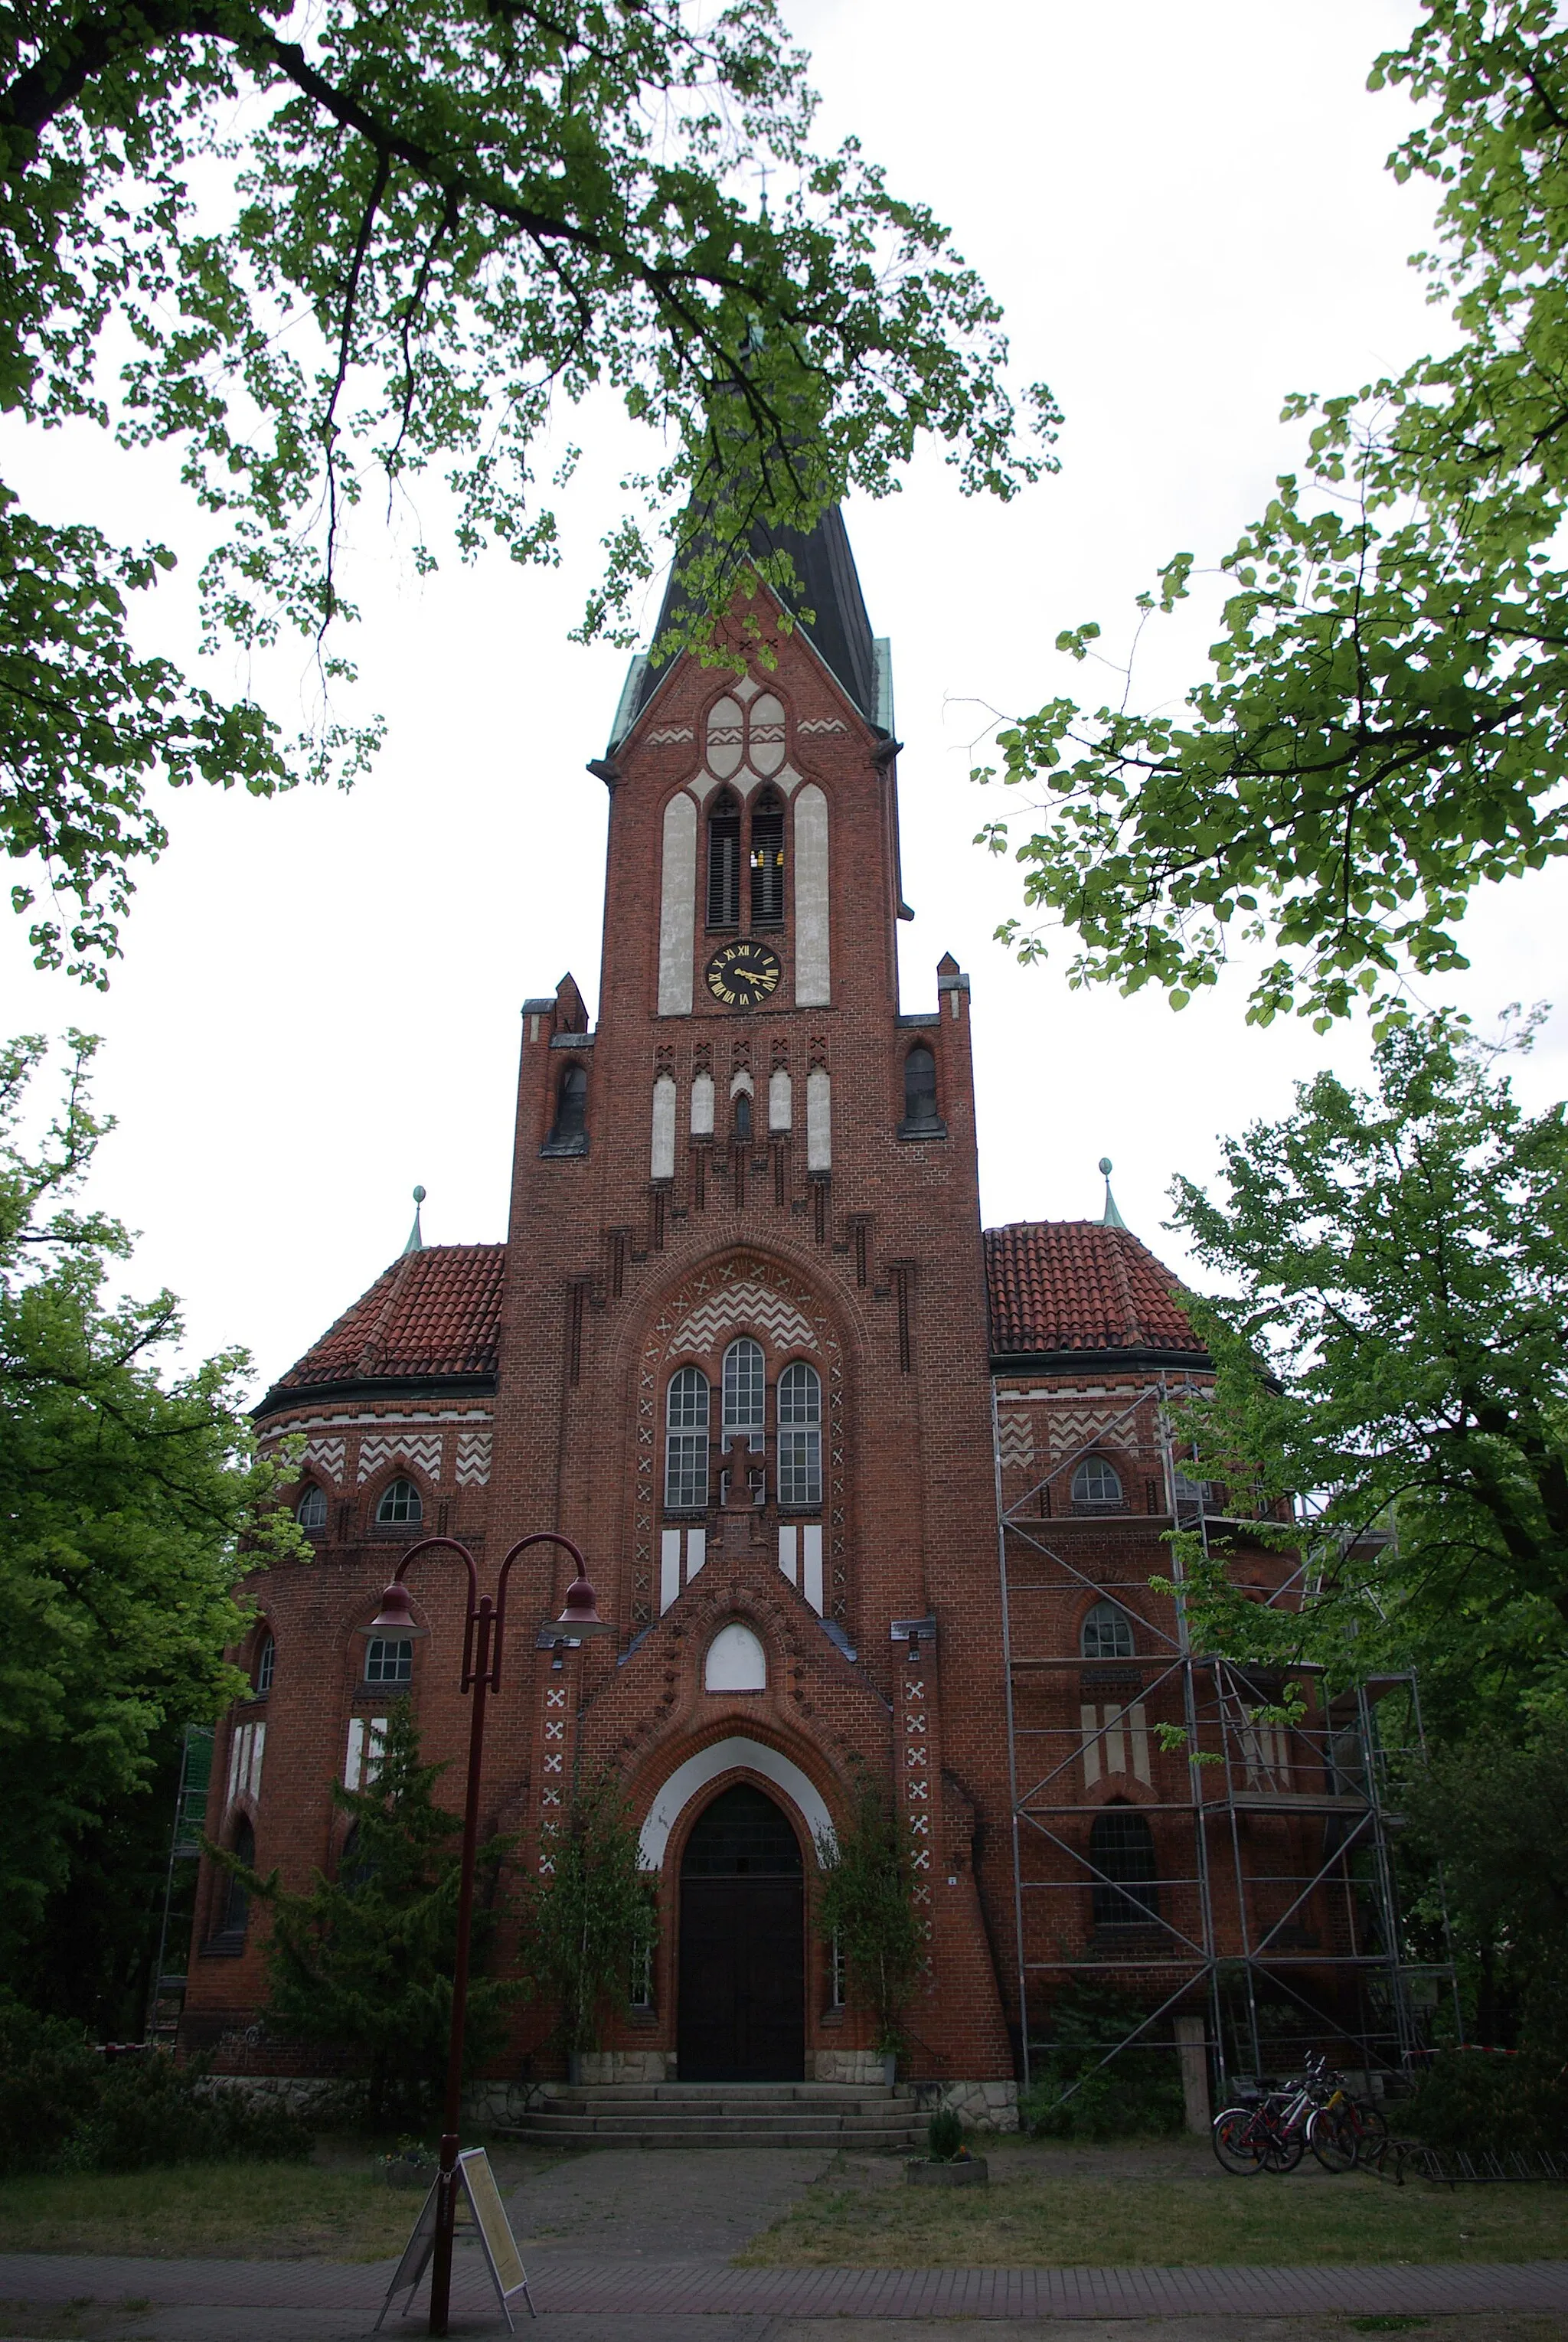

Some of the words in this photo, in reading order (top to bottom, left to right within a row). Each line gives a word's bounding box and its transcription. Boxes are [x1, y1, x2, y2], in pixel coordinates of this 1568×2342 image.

[724, 949, 736, 961] XI
[737, 946, 749, 955] XII
[712, 959, 726, 968] X
[762, 956, 774, 965] II
[723, 991, 736, 1004] VII
[740, 994, 749, 1004] VI
[754, 991, 764, 1001] V
